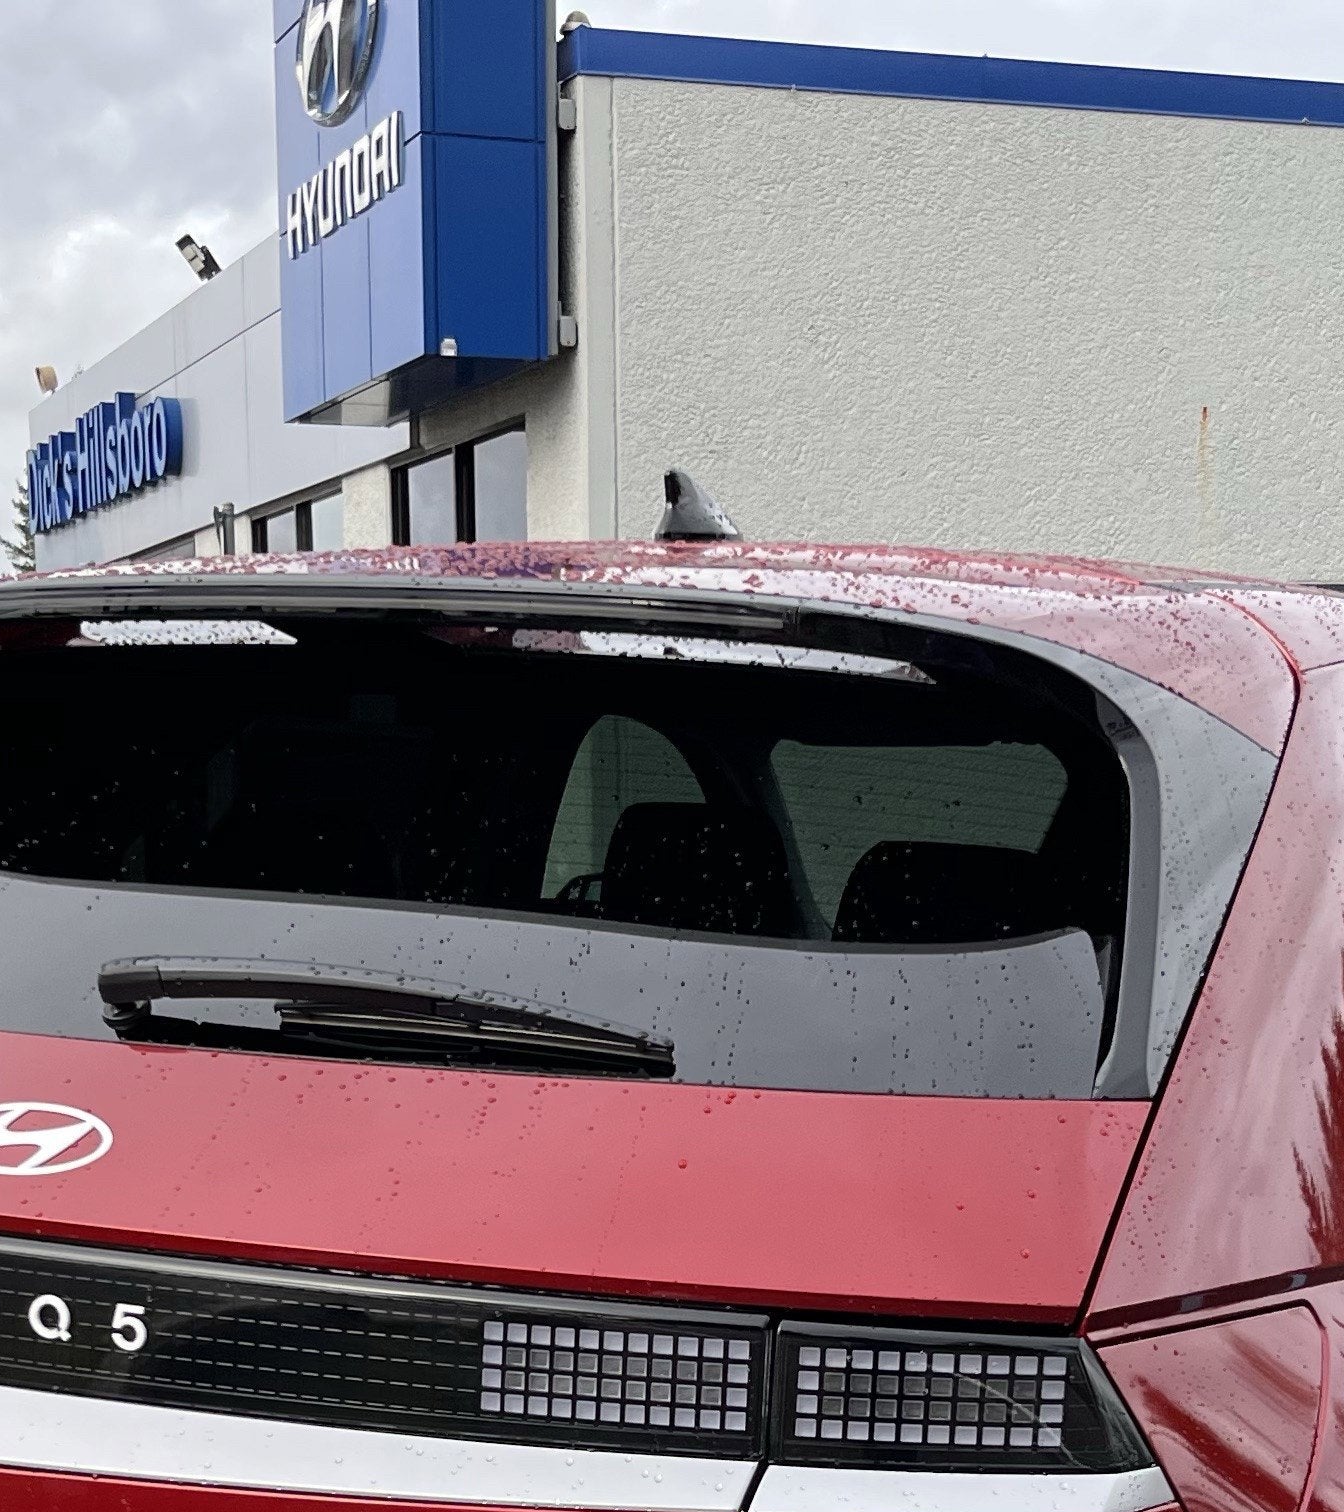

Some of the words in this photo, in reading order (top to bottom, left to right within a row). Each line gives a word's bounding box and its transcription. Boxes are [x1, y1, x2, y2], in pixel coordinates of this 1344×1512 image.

[287, 110, 402, 260] HYUNDAI
[27, 430, 74, 535] Dick's
[76, 392, 169, 513] Hillsboro
[111, 1302, 148, 1352] 5
